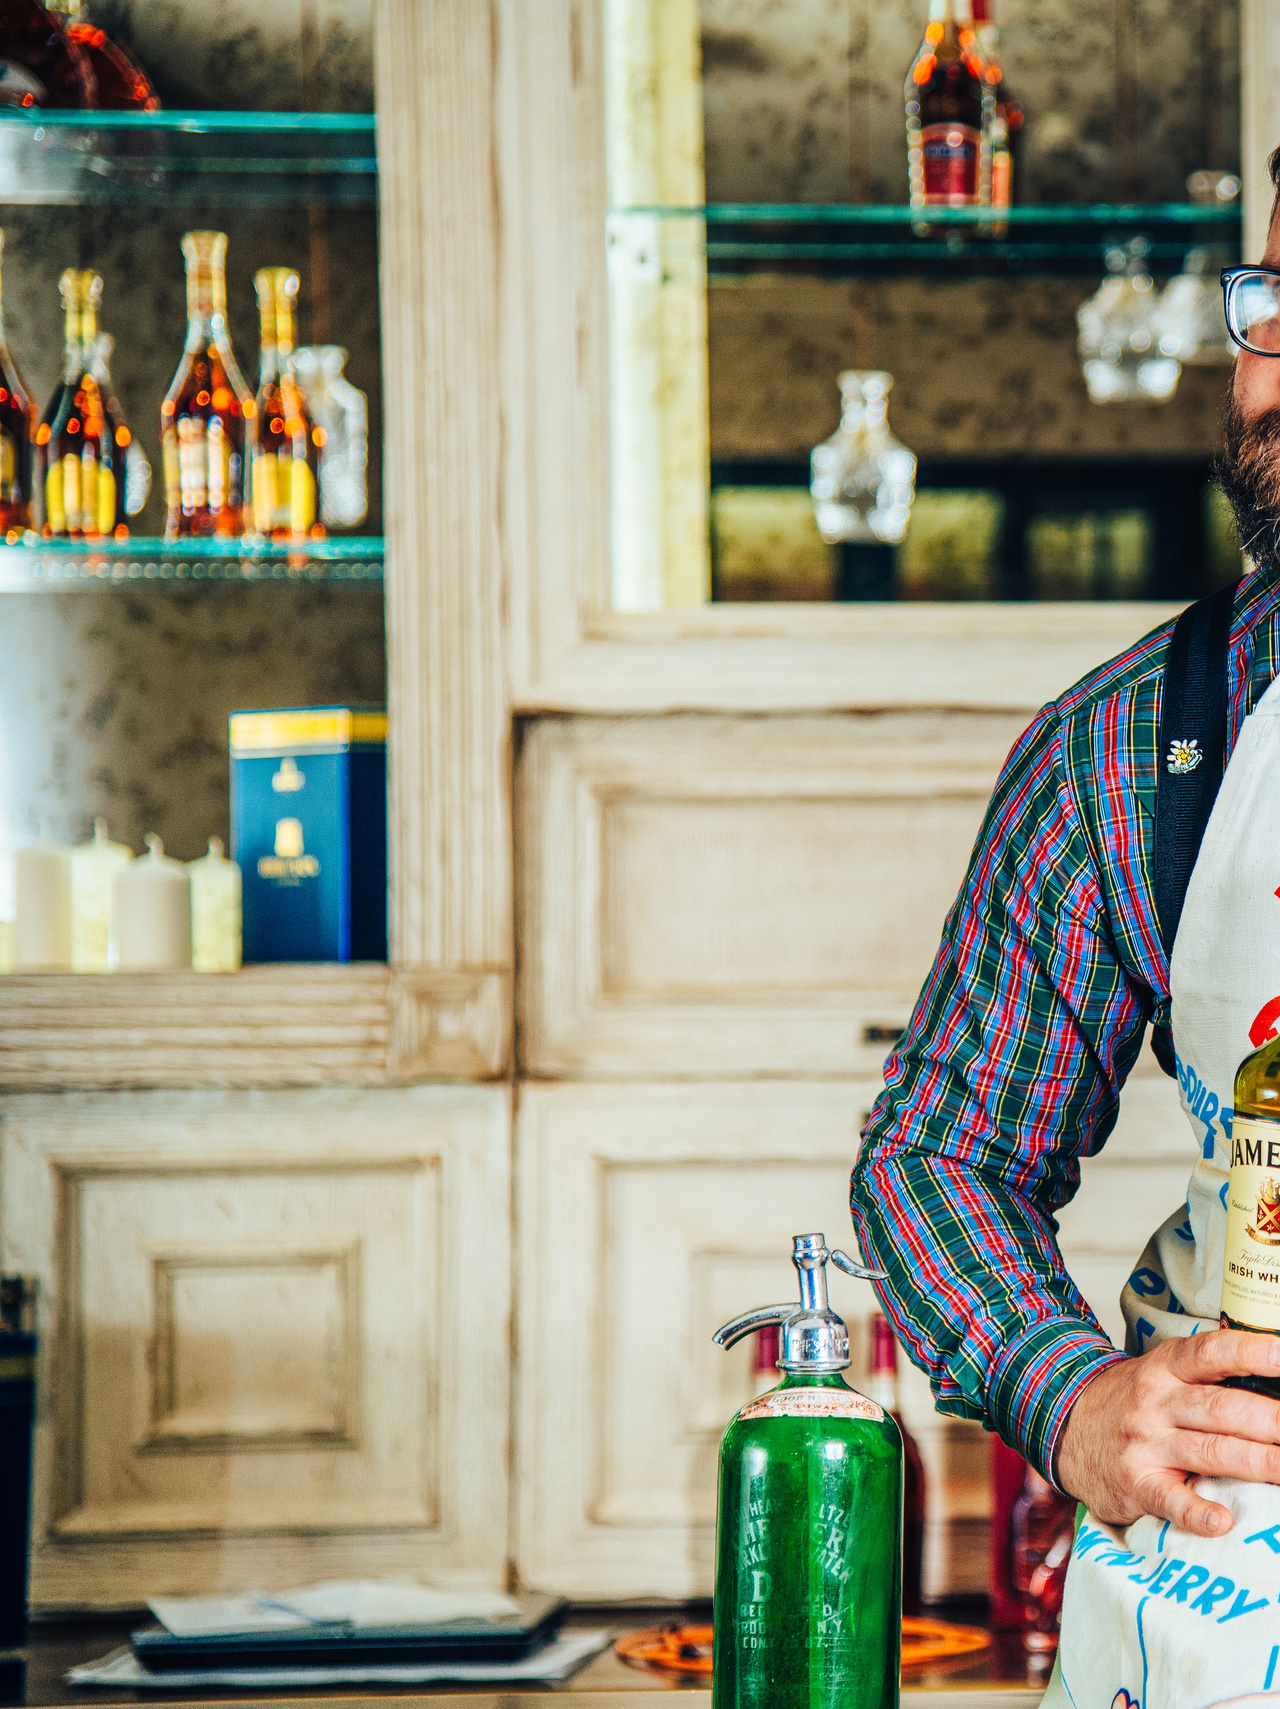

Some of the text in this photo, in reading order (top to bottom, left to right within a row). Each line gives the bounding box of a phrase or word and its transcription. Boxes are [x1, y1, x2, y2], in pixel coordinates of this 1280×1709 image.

[1237, 1248, 1262, 1266] Triple
[1228, 1261, 1254, 1279] IRISH
[1127, 1557, 1270, 1624] JERRY
